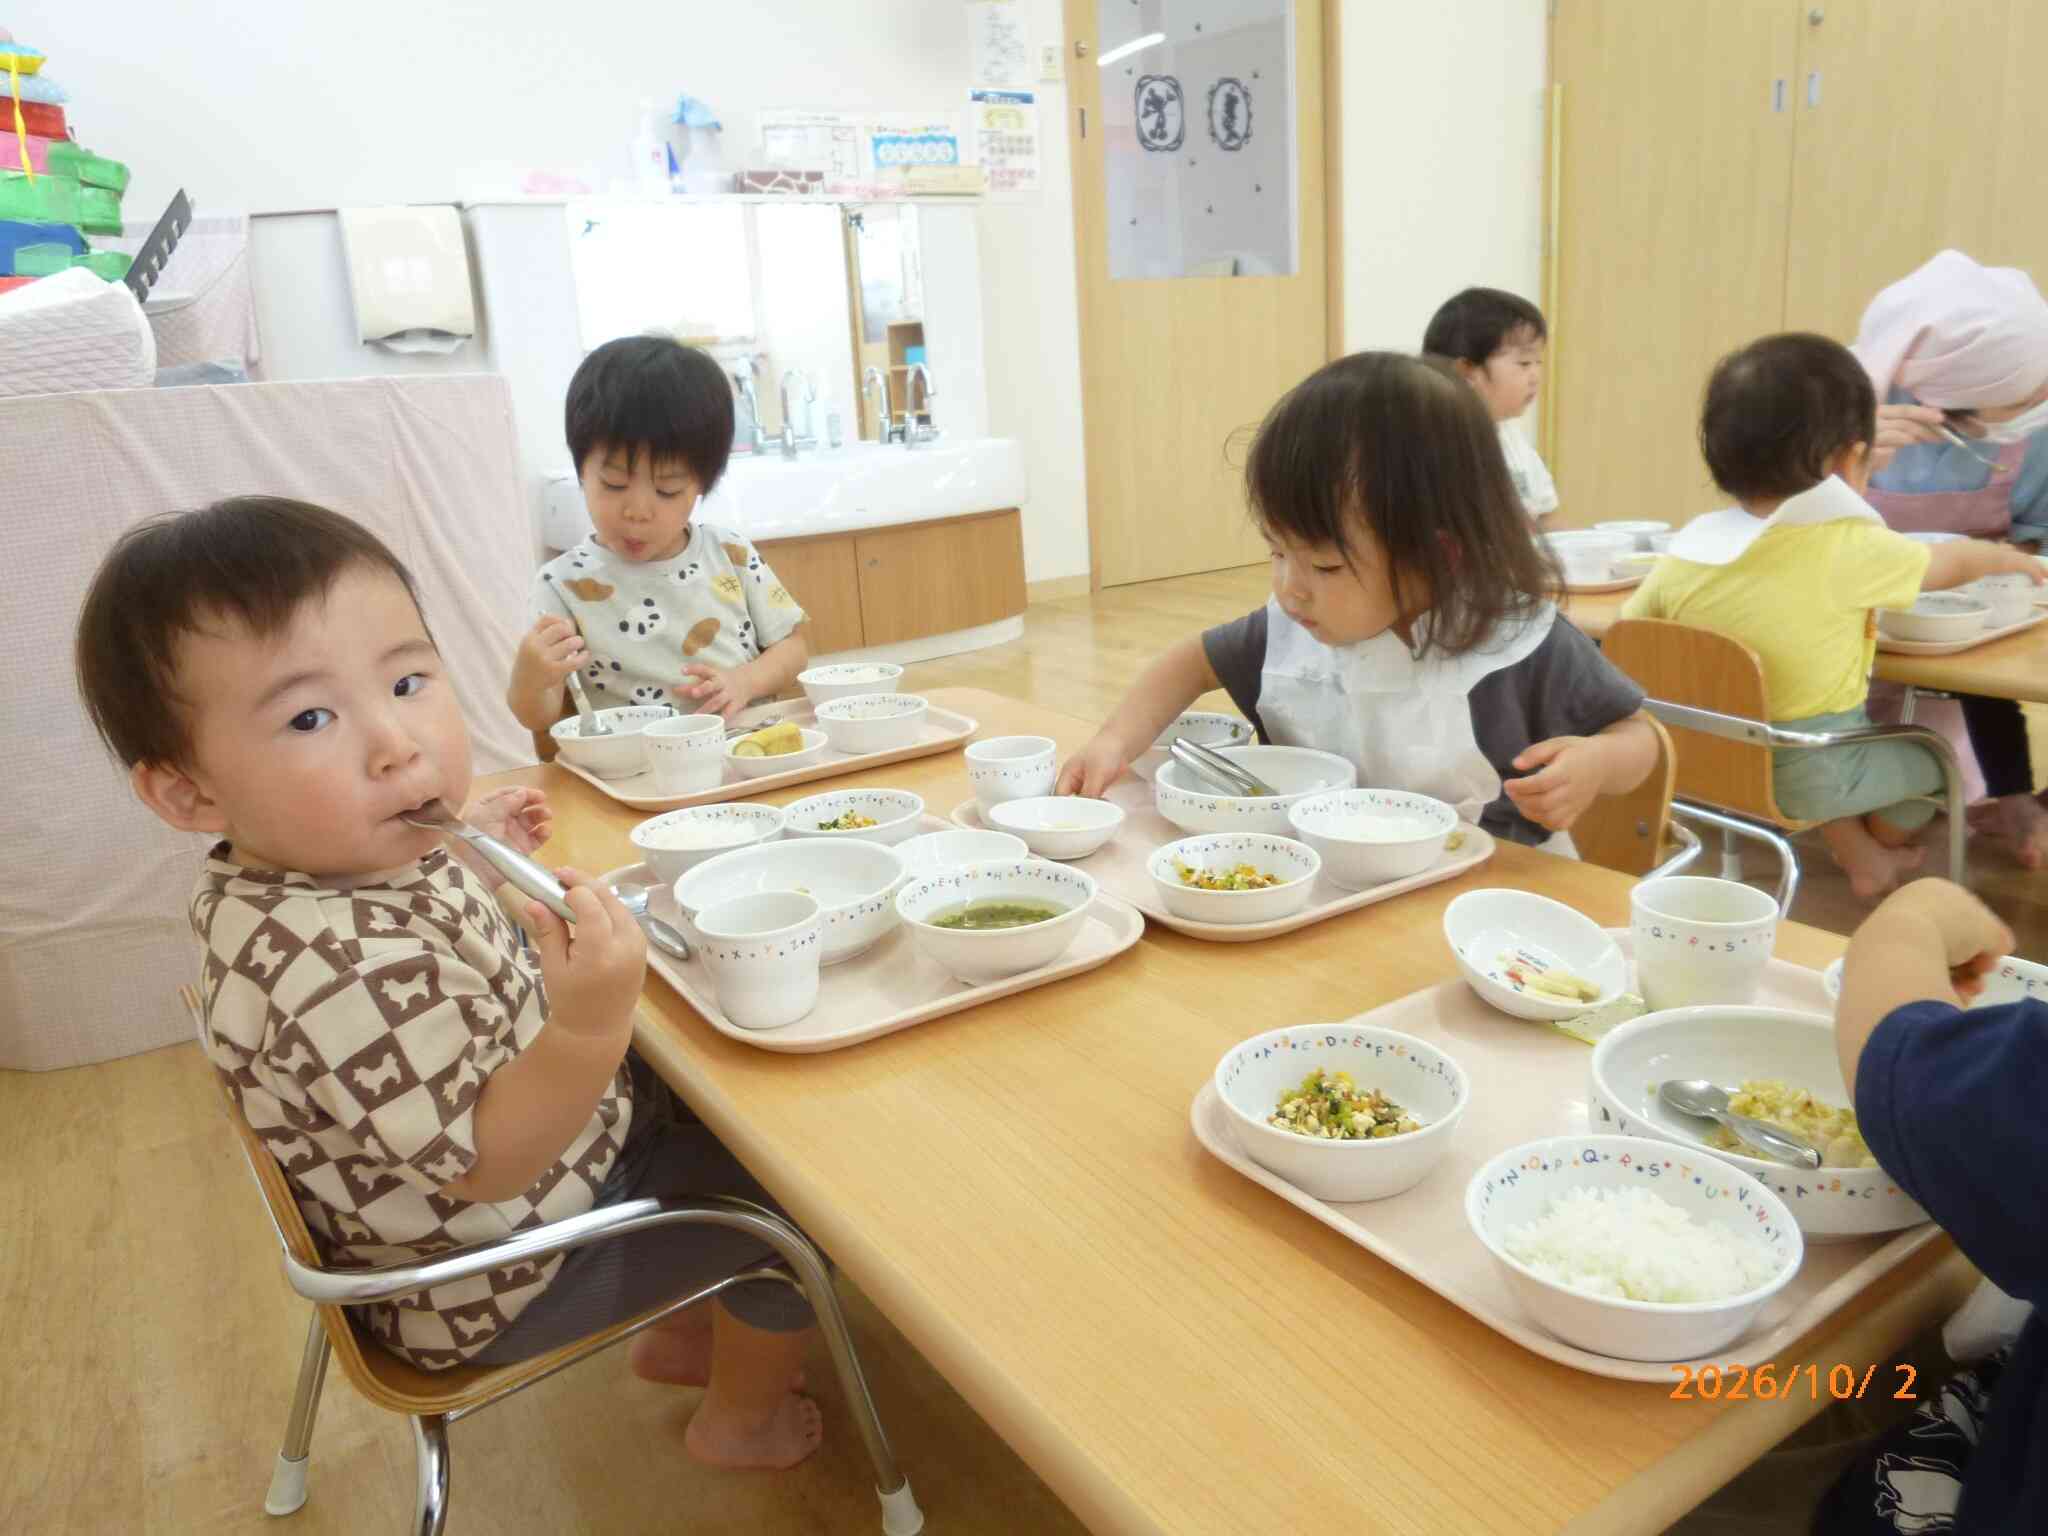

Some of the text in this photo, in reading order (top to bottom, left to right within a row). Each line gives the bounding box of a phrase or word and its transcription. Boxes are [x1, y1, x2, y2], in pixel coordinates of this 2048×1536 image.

[1651, 925, 1663, 938] Q
[1724, 941, 1736, 952] S
[1325, 1035, 1337, 1047] D
[1352, 1035, 1364, 1048] E
[1375, 1045, 1384, 1057] F
[1506, 1168, 1519, 1187] N
[1581, 1148, 1600, 1163] Q
[1649, 1162, 1661, 1177] S
[1705, 1184, 1719, 1199] U
[1737, 1186, 1750, 1201] V
[1861, 1185, 1876, 1200] C
